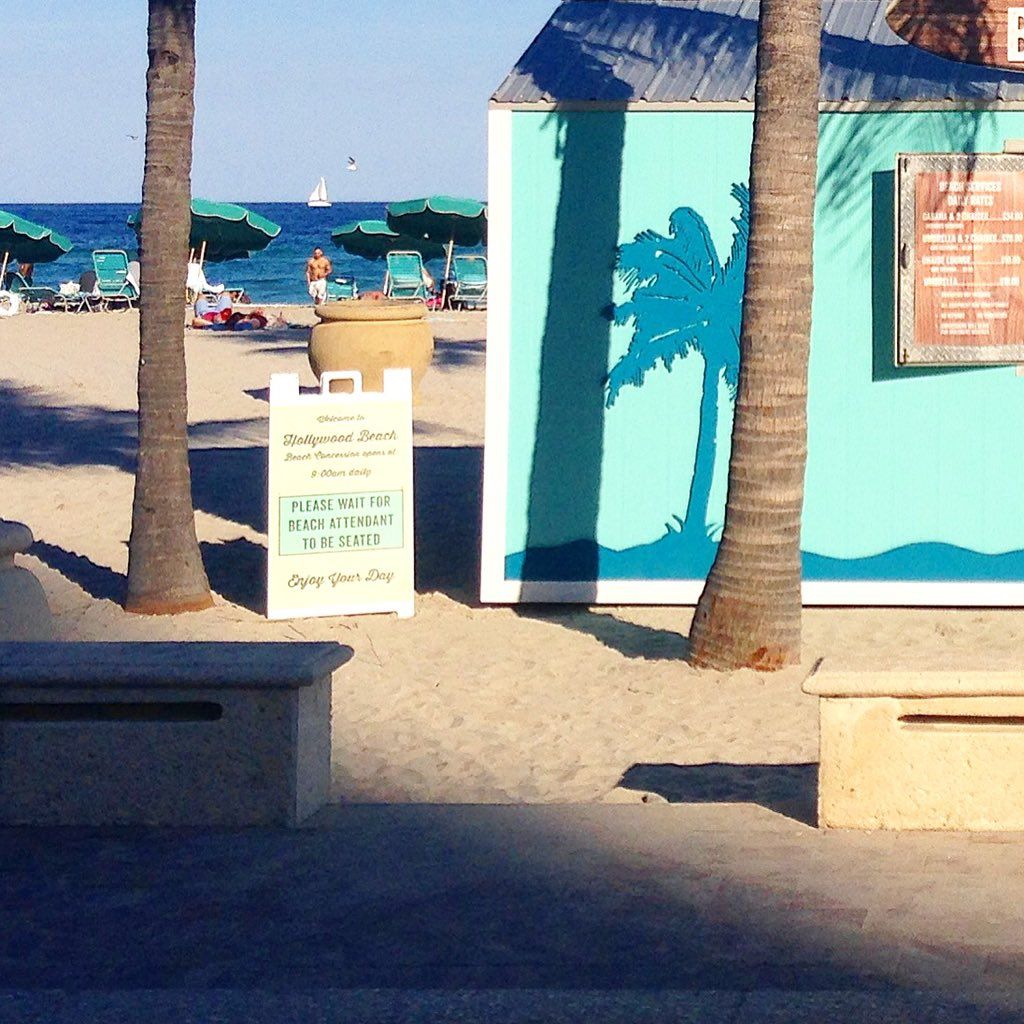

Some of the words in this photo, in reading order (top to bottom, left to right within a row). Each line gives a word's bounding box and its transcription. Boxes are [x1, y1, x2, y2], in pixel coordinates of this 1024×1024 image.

[970, 195, 994, 206] RATES
[922, 233, 957, 243] UMBRELLA
[283, 431, 354, 448] Hollywood
[357, 429, 399, 443] Beach
[284, 452, 313, 462] Beach
[314, 450, 360, 461] Concession
[362, 450, 386, 459] opens
[387, 448, 397, 456] at
[348, 467, 373, 478] daily
[291, 498, 335, 513] PLEASE
[338, 496, 366, 510] WAIT
[370, 495, 391, 508] FOR
[288, 518, 326, 533] BEACH
[329, 513, 395, 530] ATTENDANT
[302, 537, 317, 550] TO
[320, 536, 335, 549] BE
[338, 533, 381, 548] SEATED
[287, 573, 325, 591] Enjoy
[328, 572, 362, 588] Your
[364, 568, 395, 584] Day
